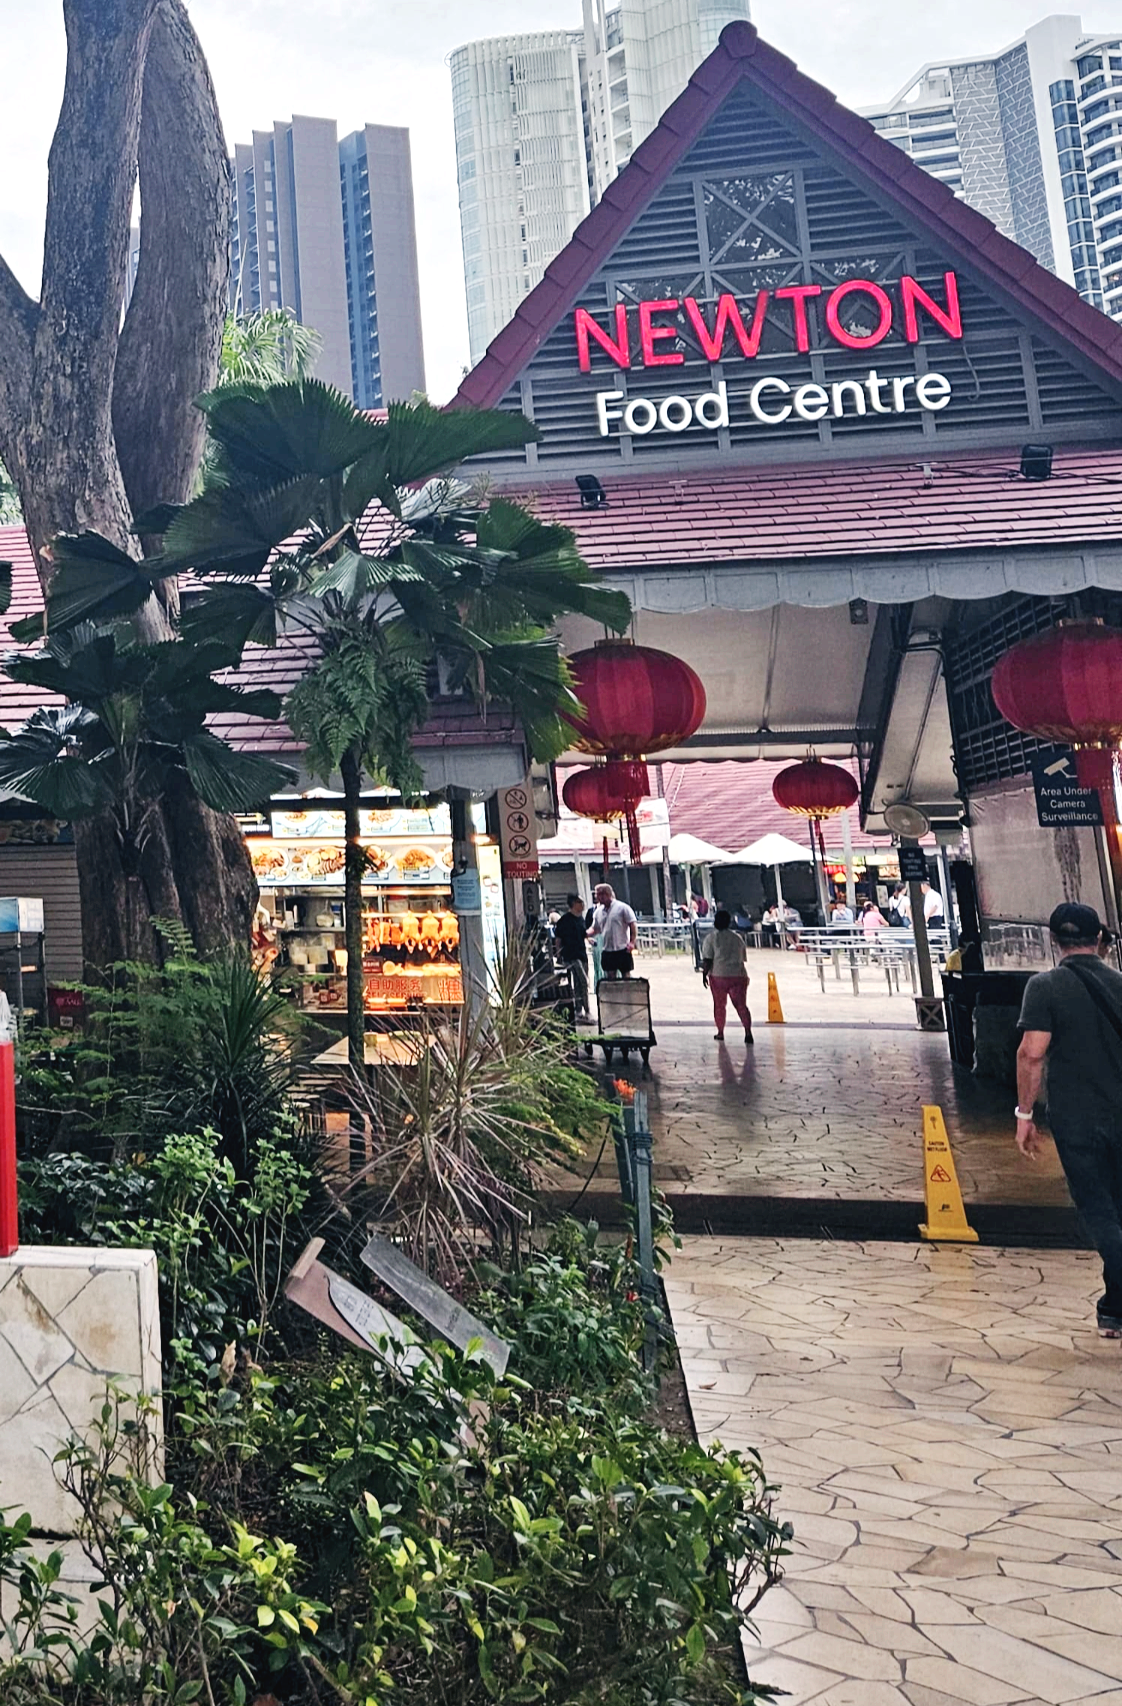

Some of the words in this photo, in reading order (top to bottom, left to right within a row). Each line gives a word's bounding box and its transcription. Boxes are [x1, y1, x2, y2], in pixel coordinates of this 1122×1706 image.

[574, 271, 962, 372] NEWTON
[595, 380, 730, 436] Food
[750, 370, 952, 424] Centre
[1040, 786, 1062, 796] Area
[1064, 786, 1092, 796] Under
[1050, 799, 1086, 809] Camera
[1041, 811, 1099, 822] Surveillance
[507, 870, 538, 878] TOUTING
[369, 978, 422, 990] 自助服务
